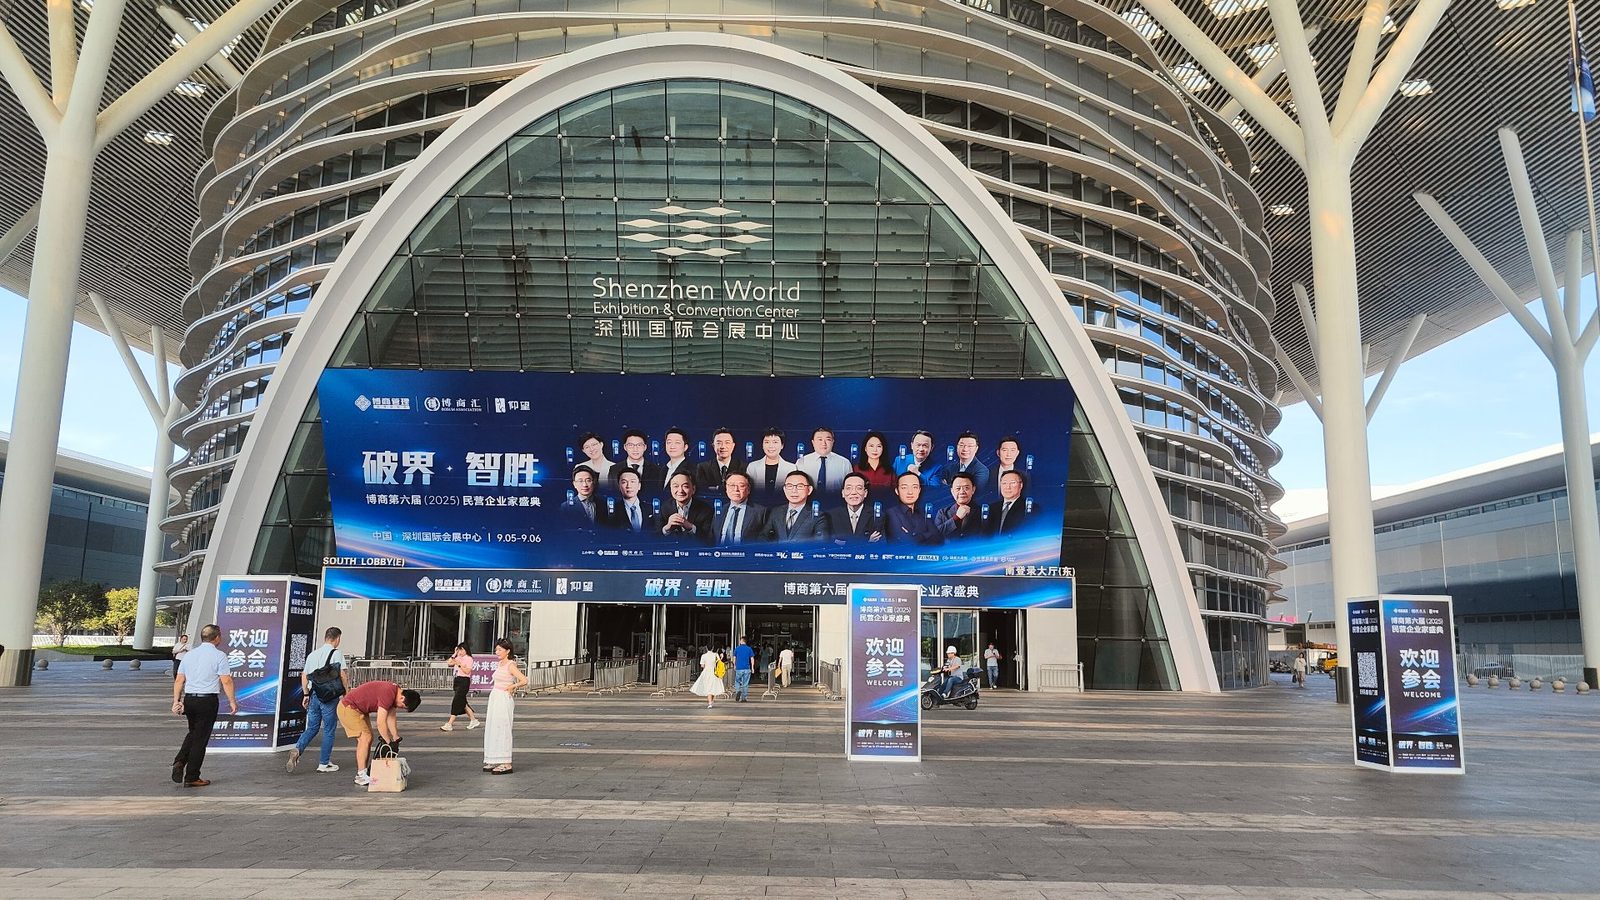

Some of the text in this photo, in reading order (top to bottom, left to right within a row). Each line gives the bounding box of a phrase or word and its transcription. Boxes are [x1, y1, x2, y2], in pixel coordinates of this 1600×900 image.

[592, 277, 801, 301] Shenzhen World
[593, 301, 800, 318] Exhibition & Convention Center
[594, 320, 800, 340] 深圳国际会展中心
[442, 397, 481, 407] 博商汇
[508, 399, 530, 410] 仰望
[362, 450, 435, 485] 破界
[466, 452, 541, 487] 智胜
[372, 531, 541, 543] 中国 深圳国际会展中心 9.05-9.06
[323, 556, 405, 567] SOUTH LOBBY(E)
[1005, 565, 1076, 577] 南登录大厅(东)
[503, 578, 541, 588] 博商汇
[570, 581, 594, 592] 仰望
[644, 578, 732, 597] 破界 智胜
[782, 582, 846, 596] 博商第六届
[228, 629, 269, 648] 欢迎
[866, 637, 904, 657] 欢迎
[228, 649, 267, 669] 参会
[866, 658, 904, 678] 参会
[1400, 649, 1440, 669] 欢迎
[1401, 669, 1441, 690] 参会
[1403, 691, 1442, 699] WELCOME
